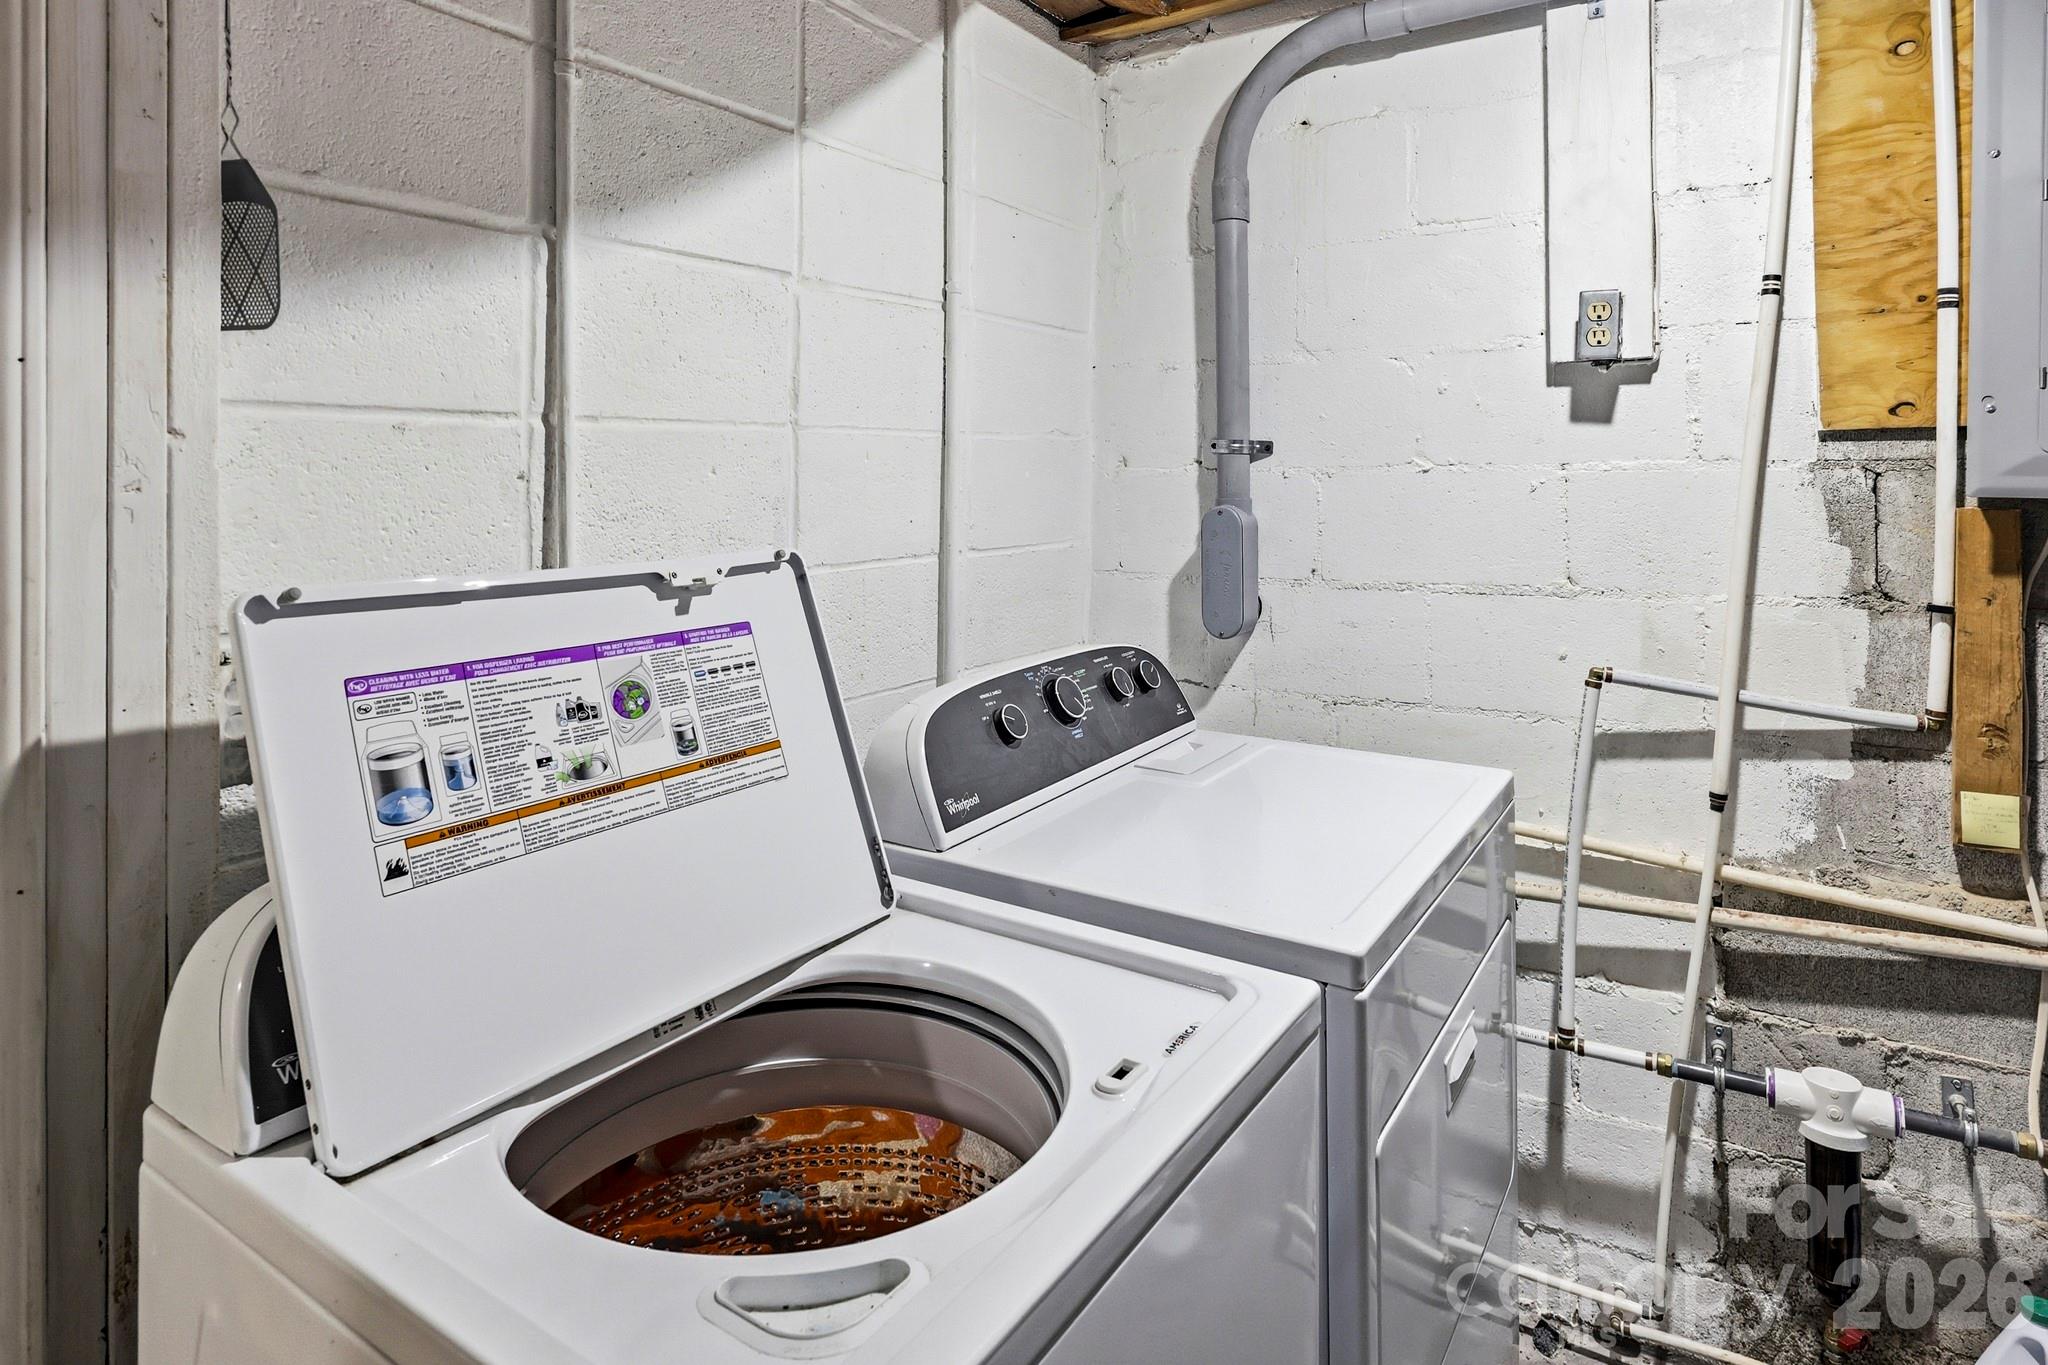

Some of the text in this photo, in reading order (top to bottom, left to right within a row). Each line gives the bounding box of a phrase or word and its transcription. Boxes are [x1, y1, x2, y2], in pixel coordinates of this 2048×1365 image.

[945, 793, 980, 815] Whirlpool
[447, 819, 489, 836] WARNING
[1164, 1025, 1199, 1055] AMERICA
